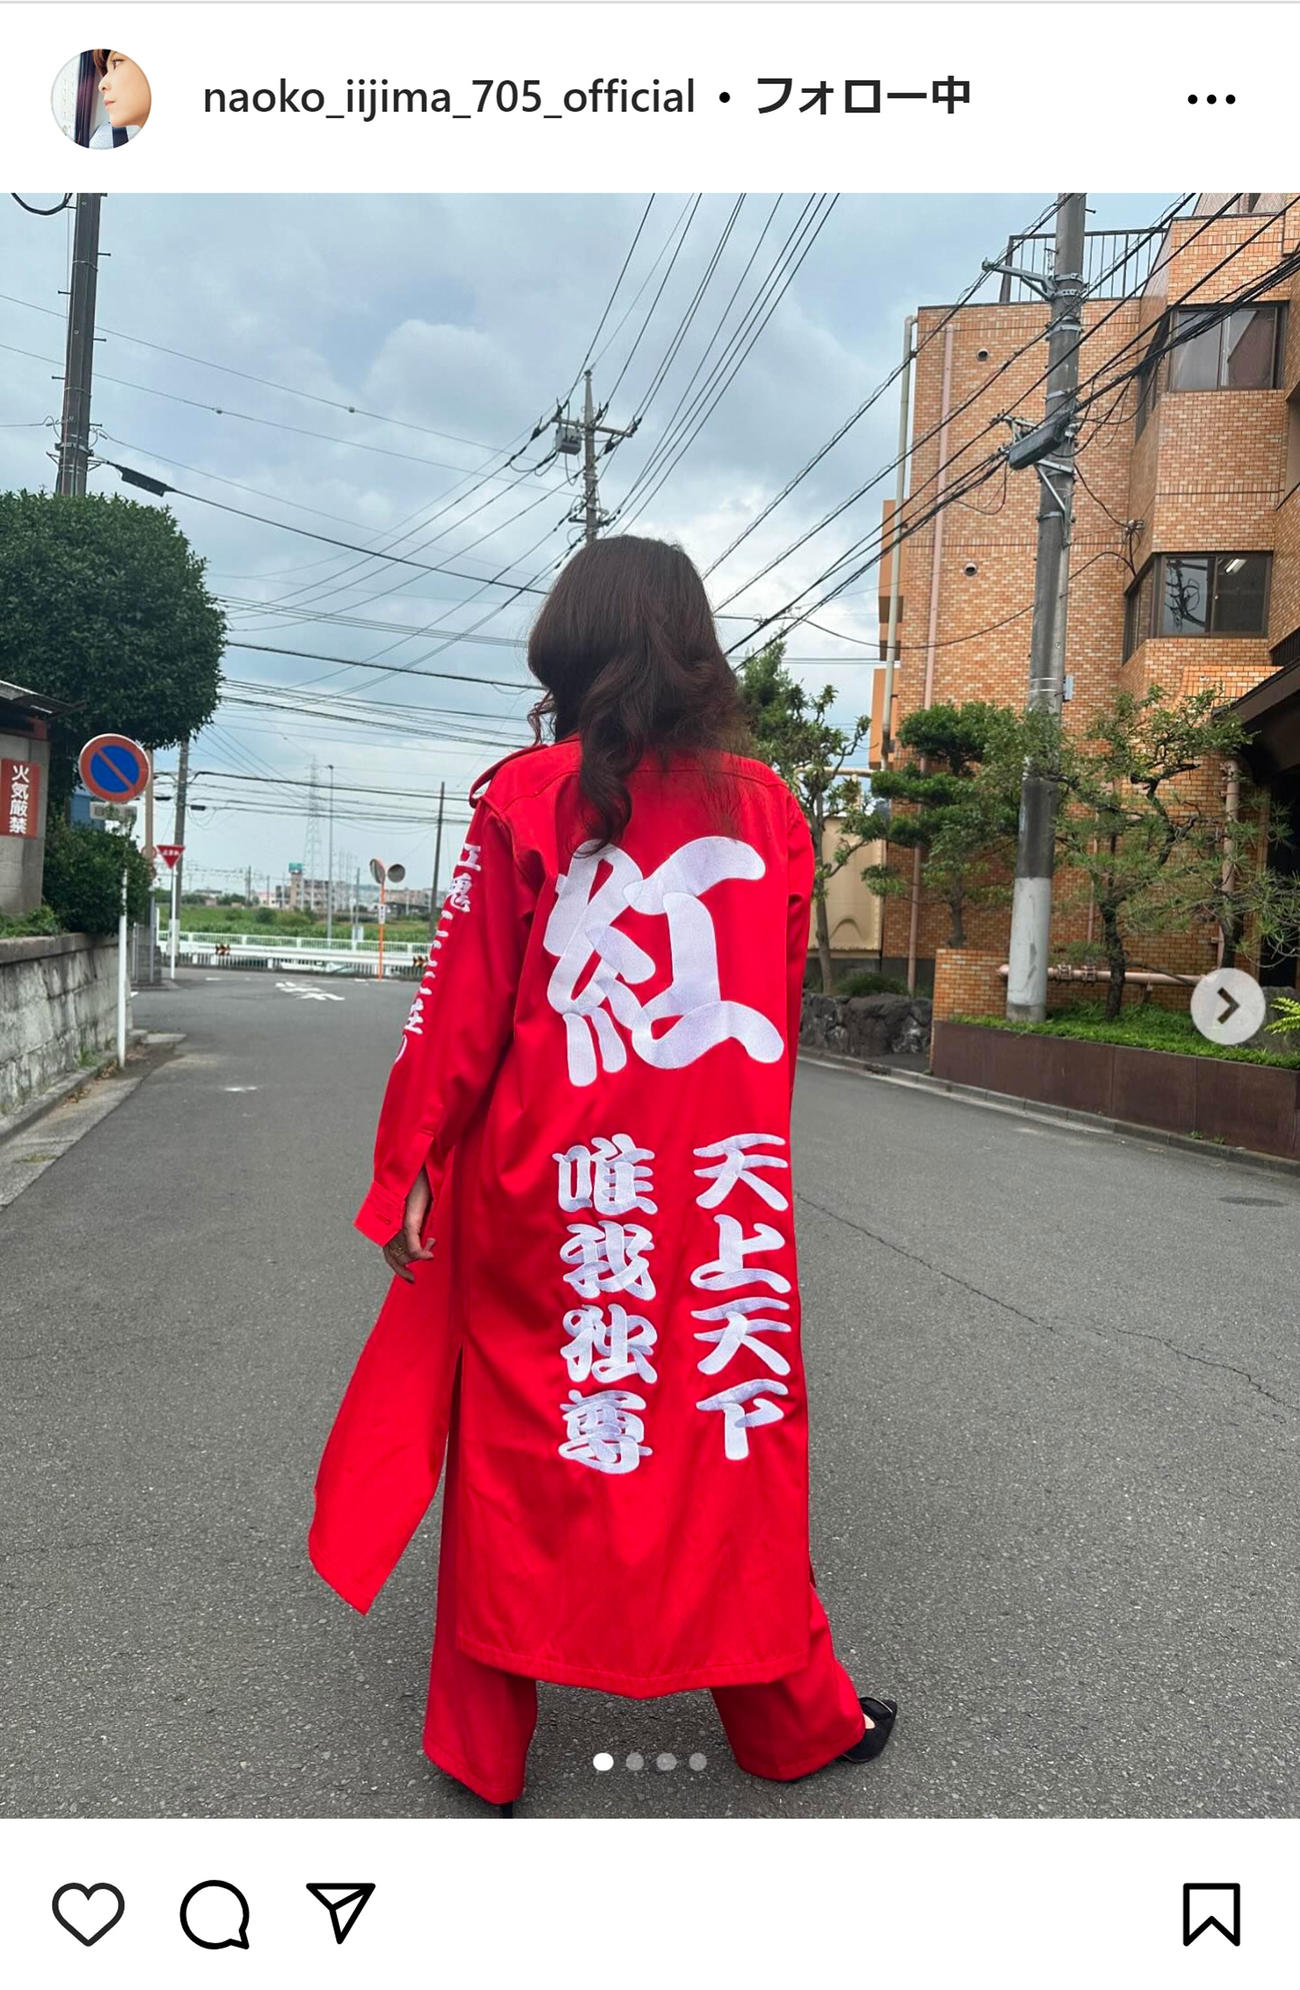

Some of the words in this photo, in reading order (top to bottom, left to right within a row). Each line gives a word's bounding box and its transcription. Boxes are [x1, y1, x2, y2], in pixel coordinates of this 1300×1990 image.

[9, 764, 30, 834] 火気厳禁
[543, 834, 785, 1087] 紅
[552, 1133, 659, 1475] 唯我独尊
[690, 1132, 792, 1461] 天上天下
